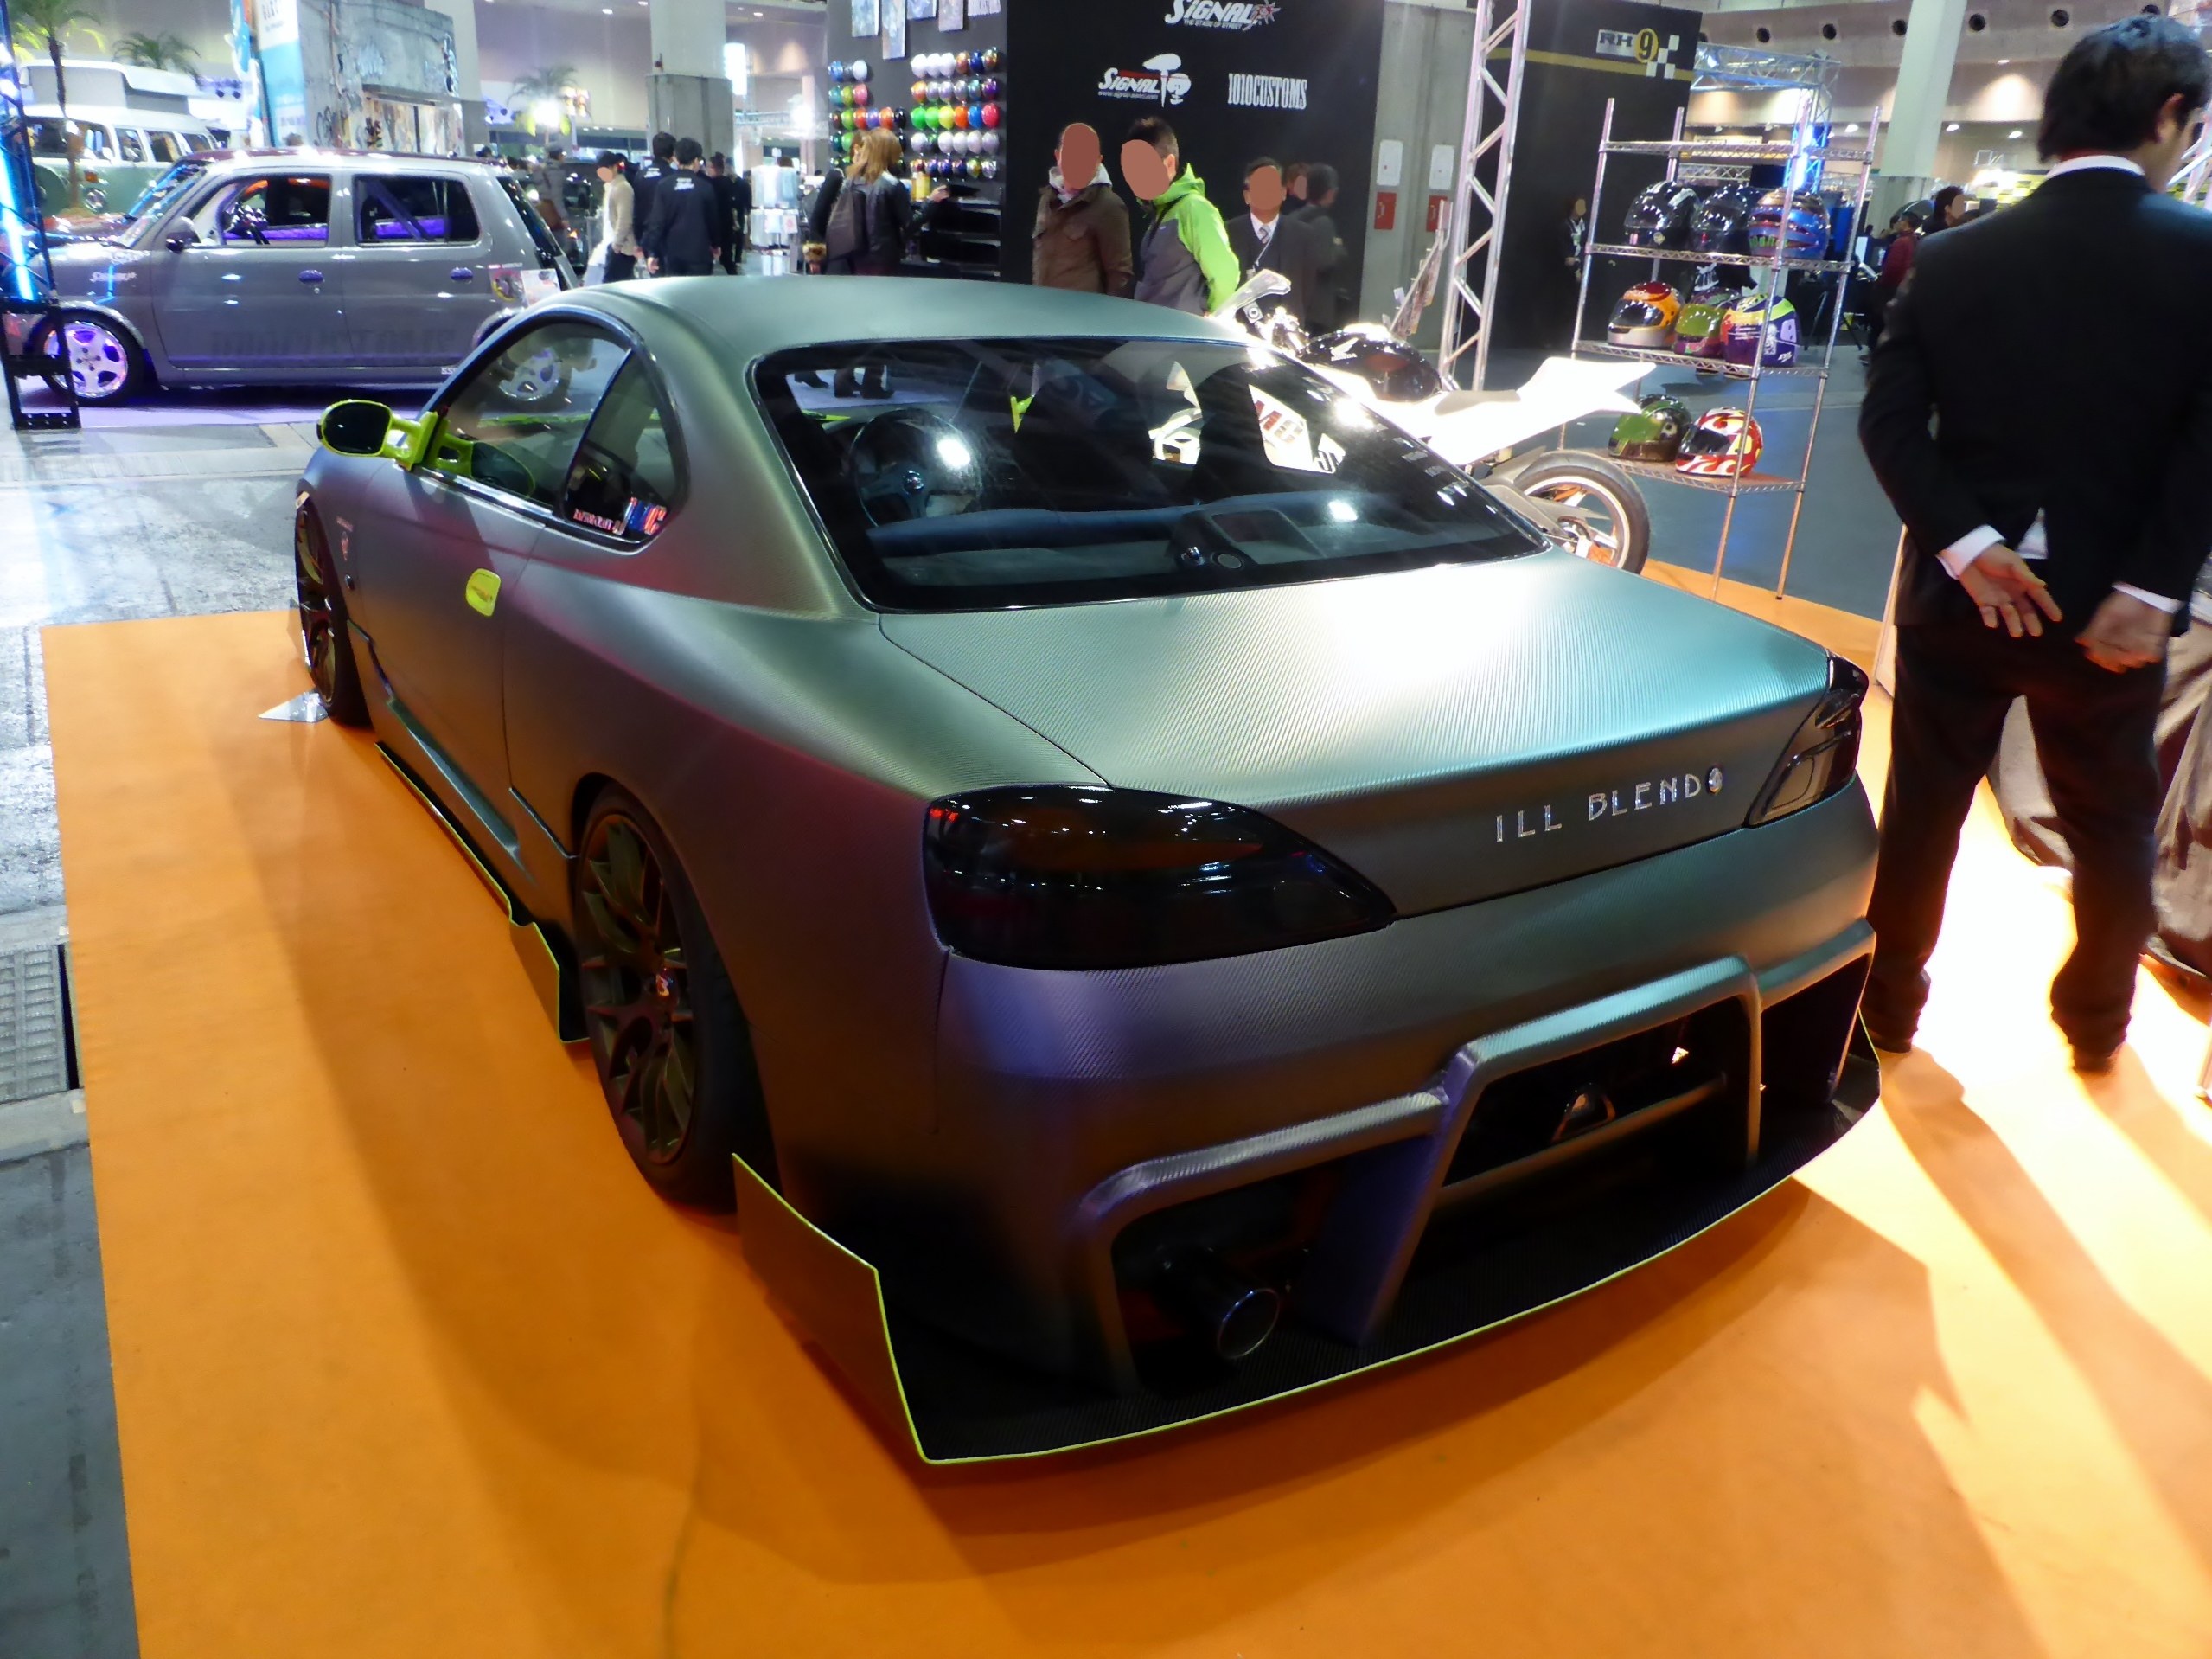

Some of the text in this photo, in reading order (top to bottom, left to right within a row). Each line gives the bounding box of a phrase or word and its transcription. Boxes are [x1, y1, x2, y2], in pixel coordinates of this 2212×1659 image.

[1098, 67, 1160, 94] SIGNAL
[1227, 73, 1308, 110] 1010CUSTOMS
[1496, 804, 1563, 842] ILL
